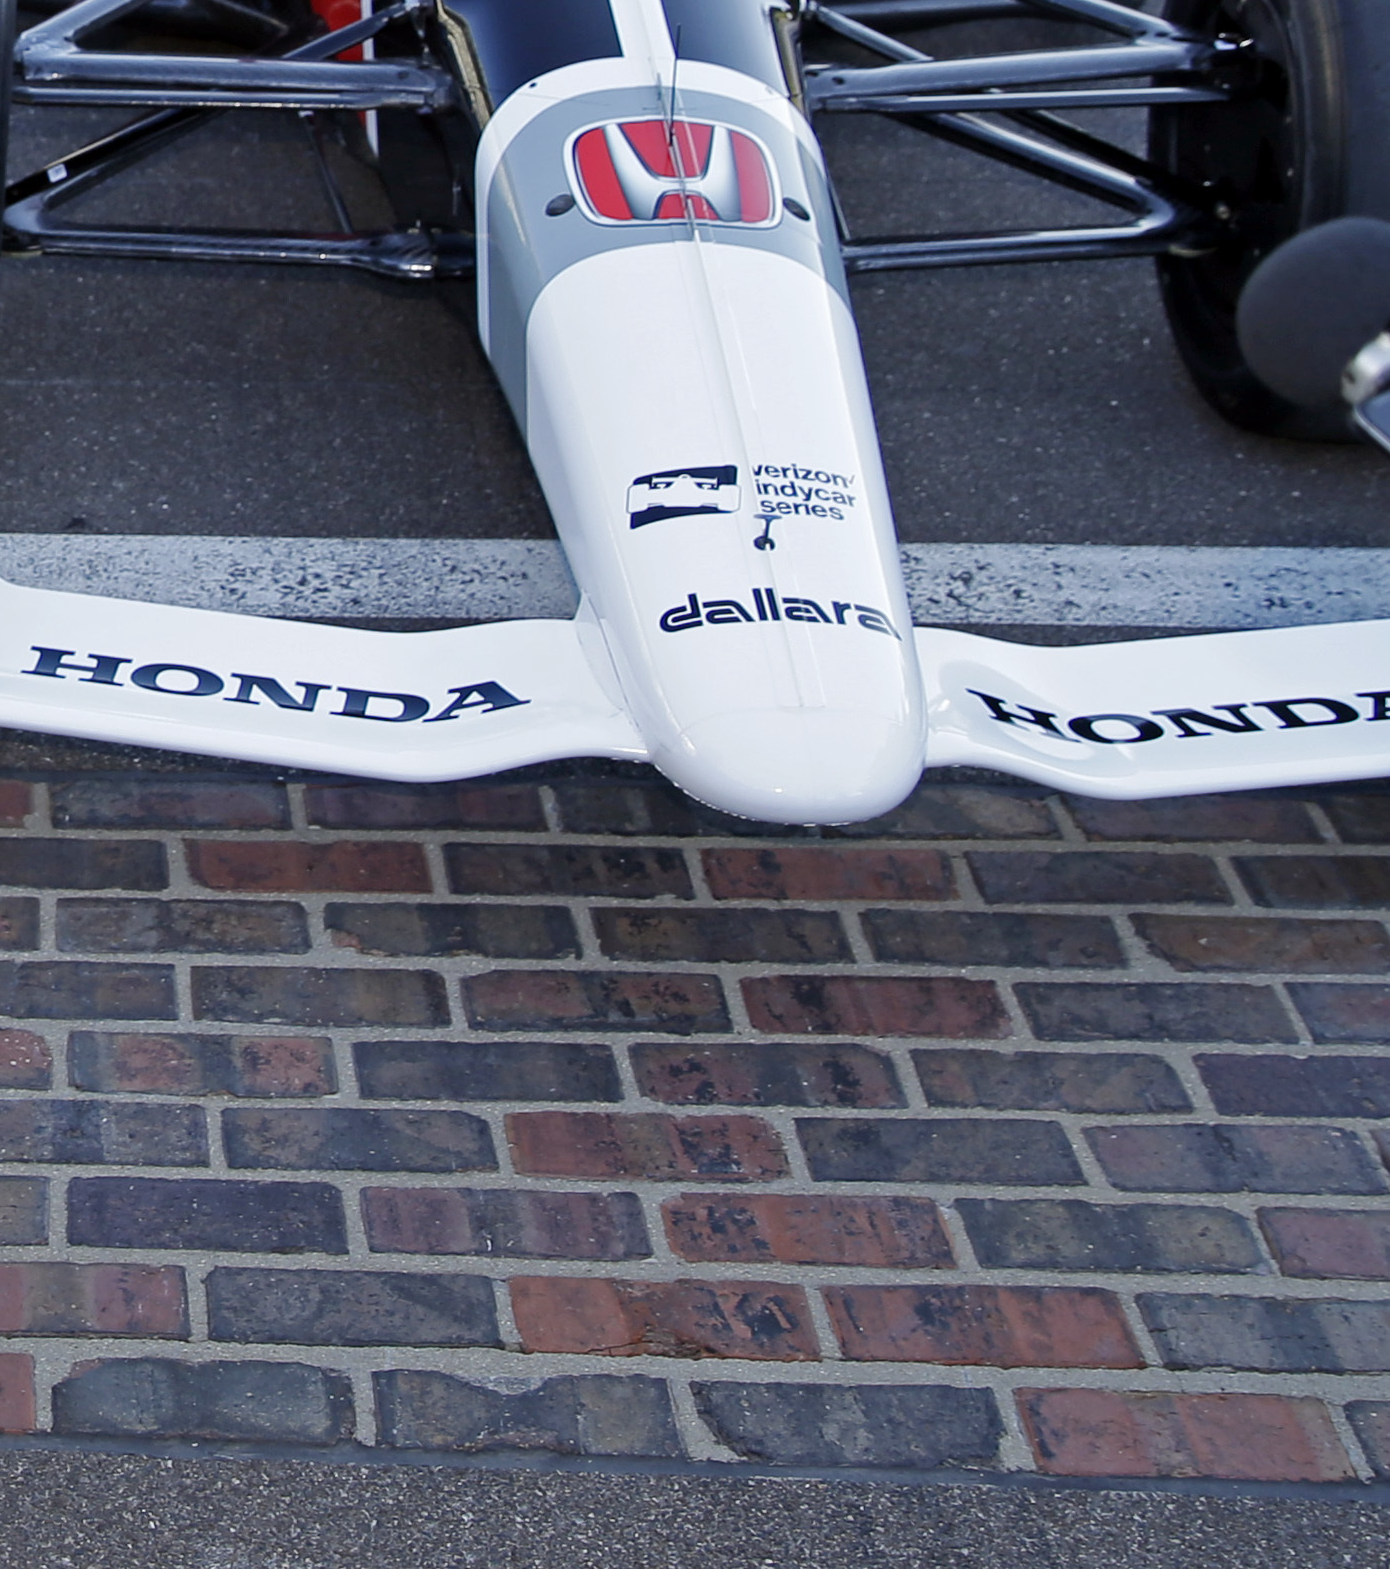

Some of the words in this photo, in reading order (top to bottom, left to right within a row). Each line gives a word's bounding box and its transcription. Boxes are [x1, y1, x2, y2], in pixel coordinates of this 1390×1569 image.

[752, 462, 848, 488] verizon
[755, 478, 857, 510] indycar
[760, 498, 845, 522] series
[660, 587, 903, 641] dallara
[20, 646, 531, 723] HONDA
